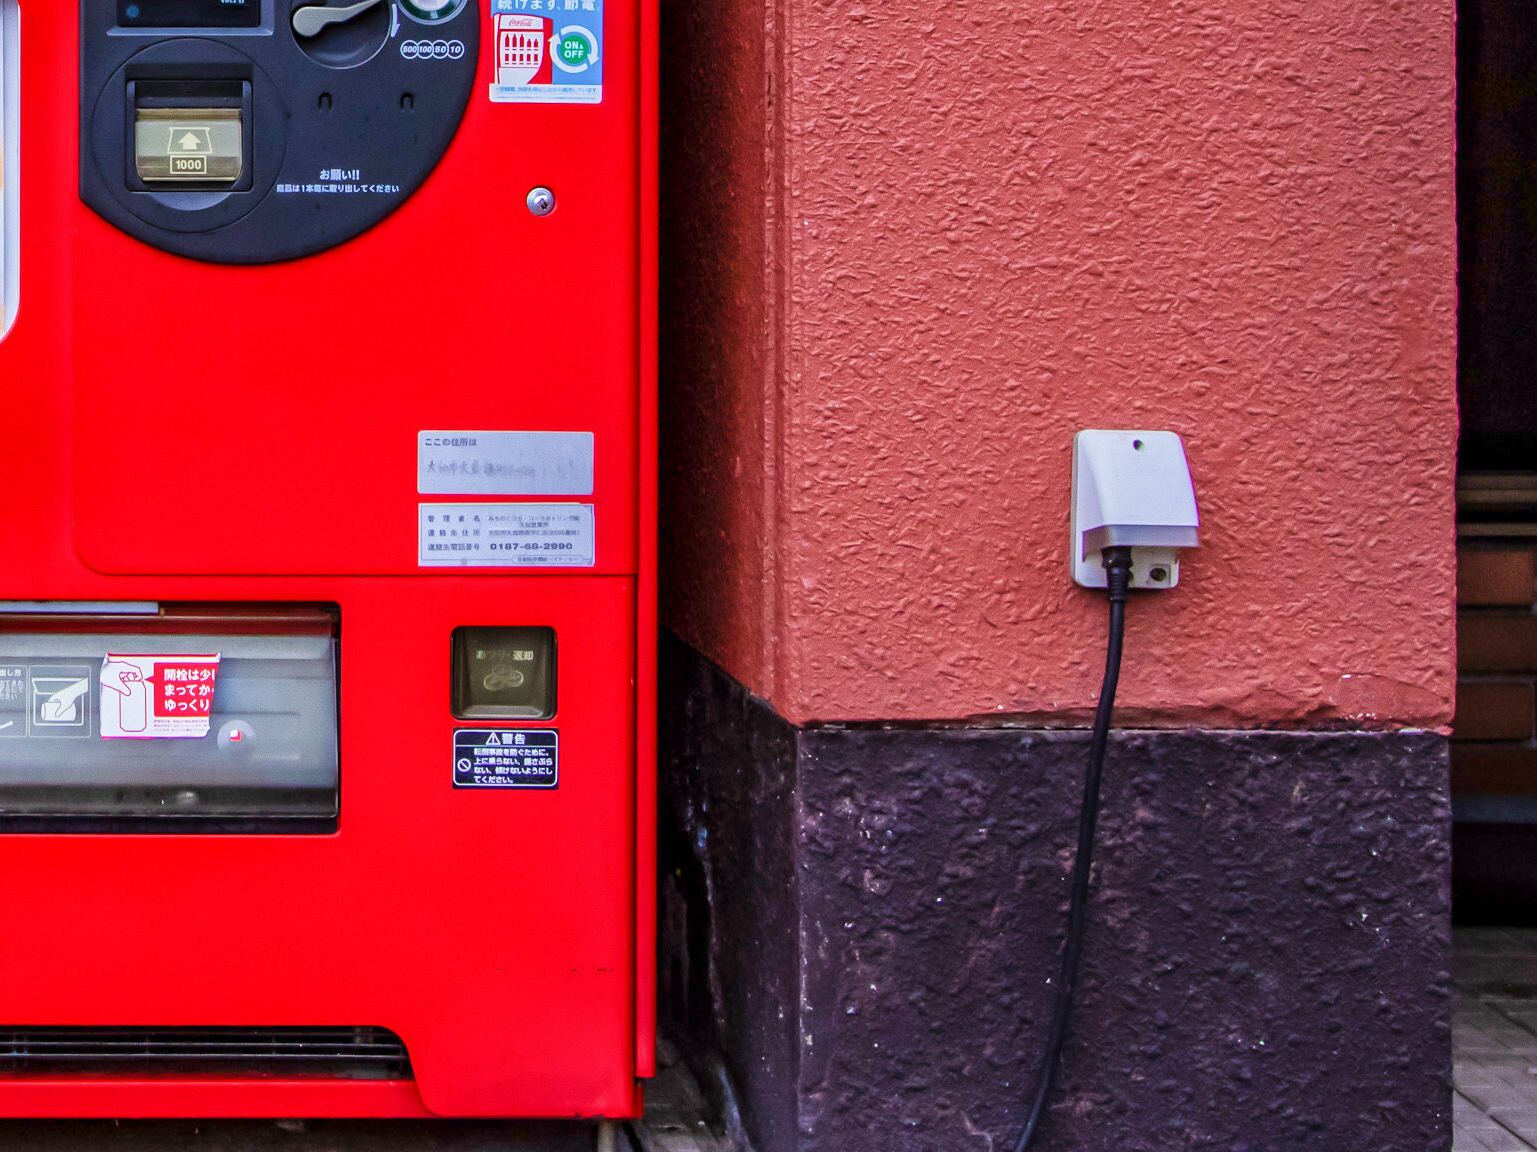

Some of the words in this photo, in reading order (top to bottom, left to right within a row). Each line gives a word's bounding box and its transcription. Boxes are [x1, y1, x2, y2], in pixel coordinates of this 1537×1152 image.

[565, 50, 584, 58] OFF
[175, 160, 202, 170] 1000
[319, 169, 360, 181] お願い!!
[425, 438, 477, 447] ここの住所は
[164, 699, 209, 712] ゆっくり
[502, 734, 526, 744] 警告
[473, 776, 514, 784] てください。
